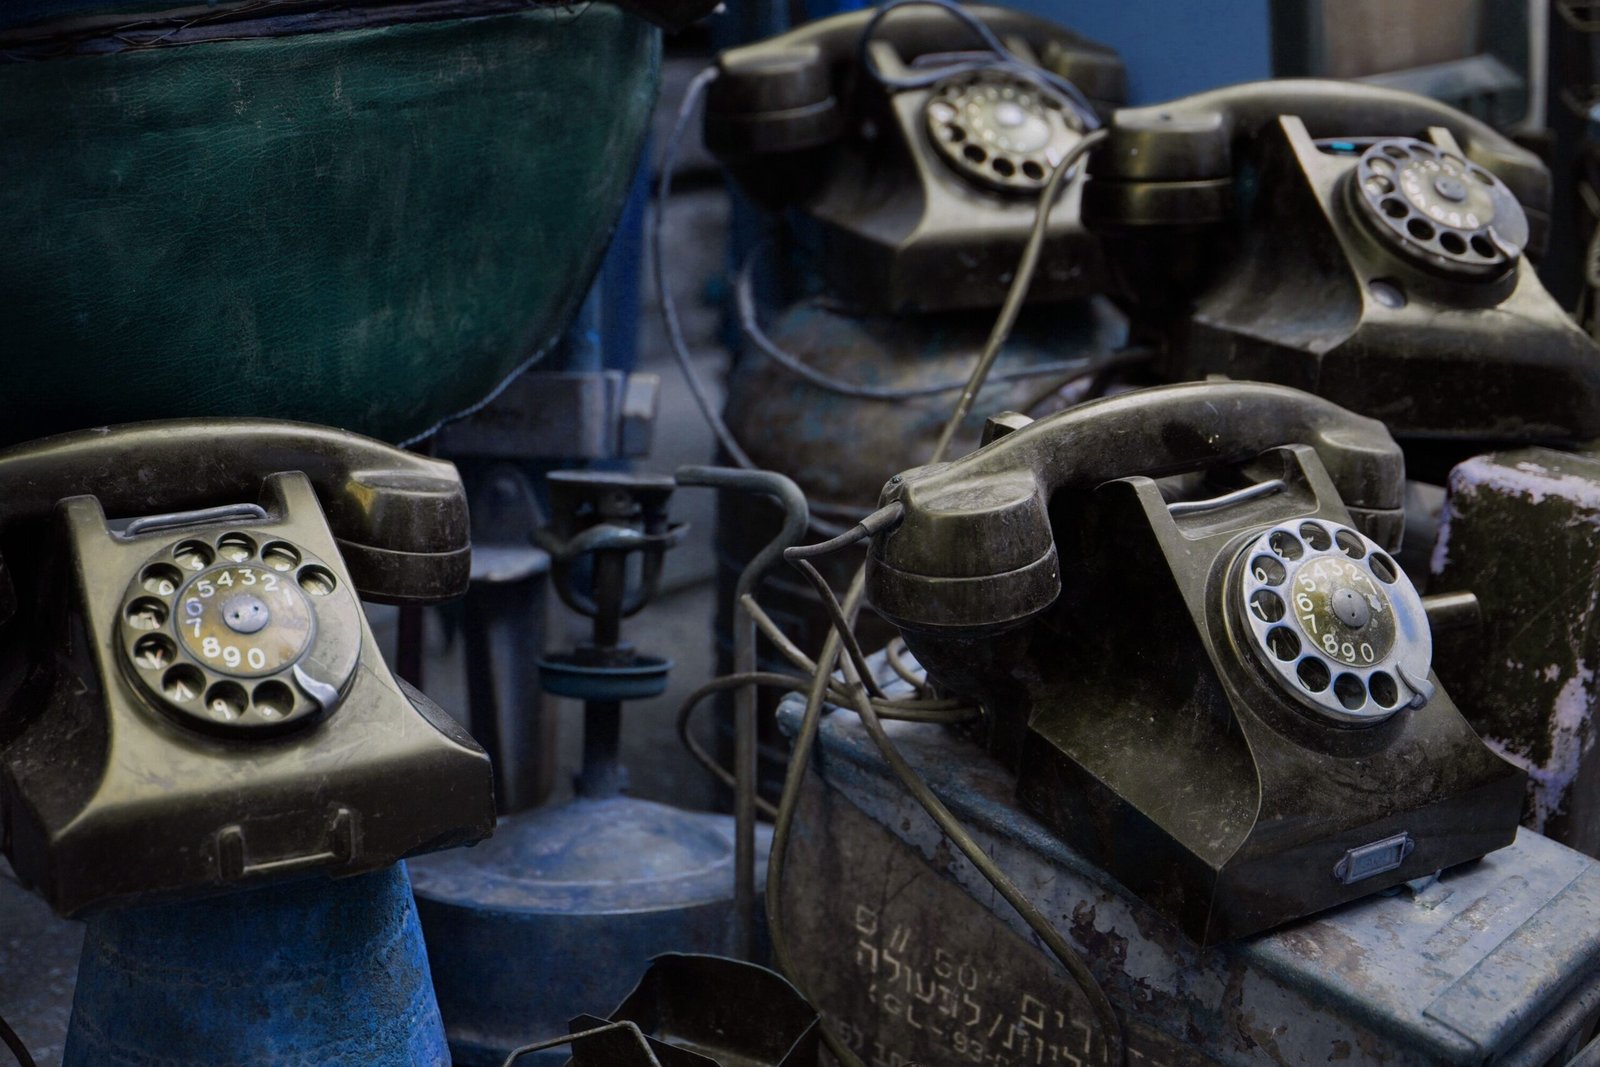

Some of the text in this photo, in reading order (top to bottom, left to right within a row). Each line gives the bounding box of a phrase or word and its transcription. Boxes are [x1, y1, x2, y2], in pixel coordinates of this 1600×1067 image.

[238, 569, 256, 585] 3
[1314, 563, 1328, 580] 4
[1325, 559, 1343, 576] 3
[1344, 563, 1362, 580] 2
[217, 571, 234, 587] 4
[261, 573, 279, 592] 2
[1298, 573, 1316, 592] 5
[197, 580, 215, 598] 5
[186, 597, 203, 616] 6
[1296, 592, 1313, 612] 6
[186, 617, 202, 638] 7
[1302, 613, 1318, 634] 7
[202, 637, 221, 658] 8
[1322, 633, 1339, 656] 8
[1341, 642, 1356, 662] 9
[1360, 642, 1374, 662] 0
[223, 646, 241, 668] 9
[247, 648, 266, 669] 0
